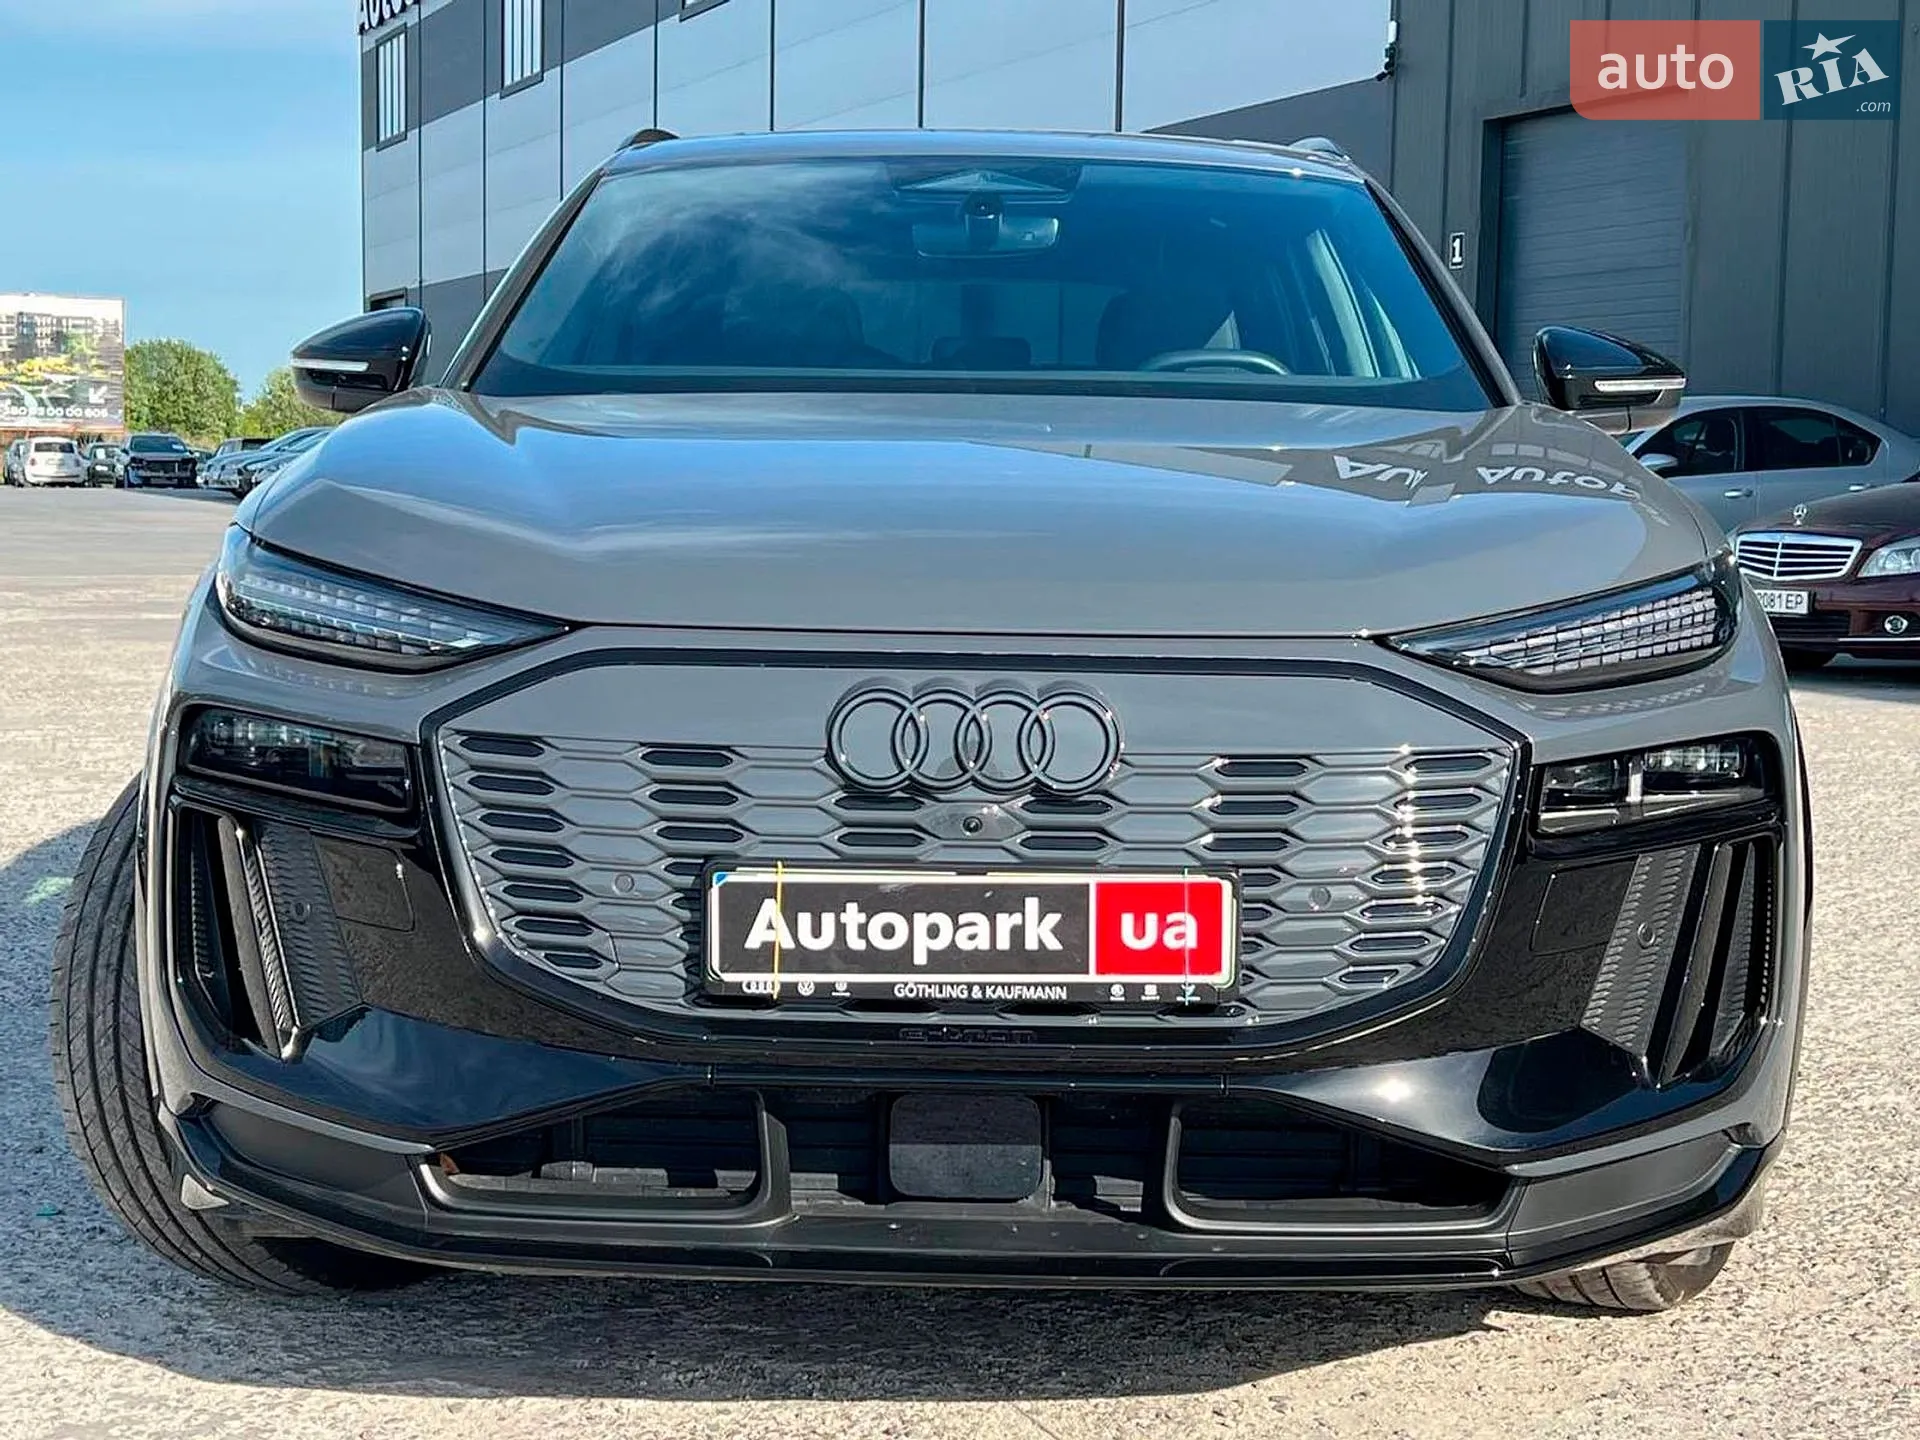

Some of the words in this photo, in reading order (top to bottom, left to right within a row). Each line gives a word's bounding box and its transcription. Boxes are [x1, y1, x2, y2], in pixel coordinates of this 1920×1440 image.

[1452, 238, 1462, 262] 1
[744, 896, 1063, 965] Autopark
[1120, 909, 1198, 951] ua
[894, 981, 968, 998] GÖTHLING
[971, 984, 983, 999] &
[985, 984, 1067, 1000] KAUFMANN
